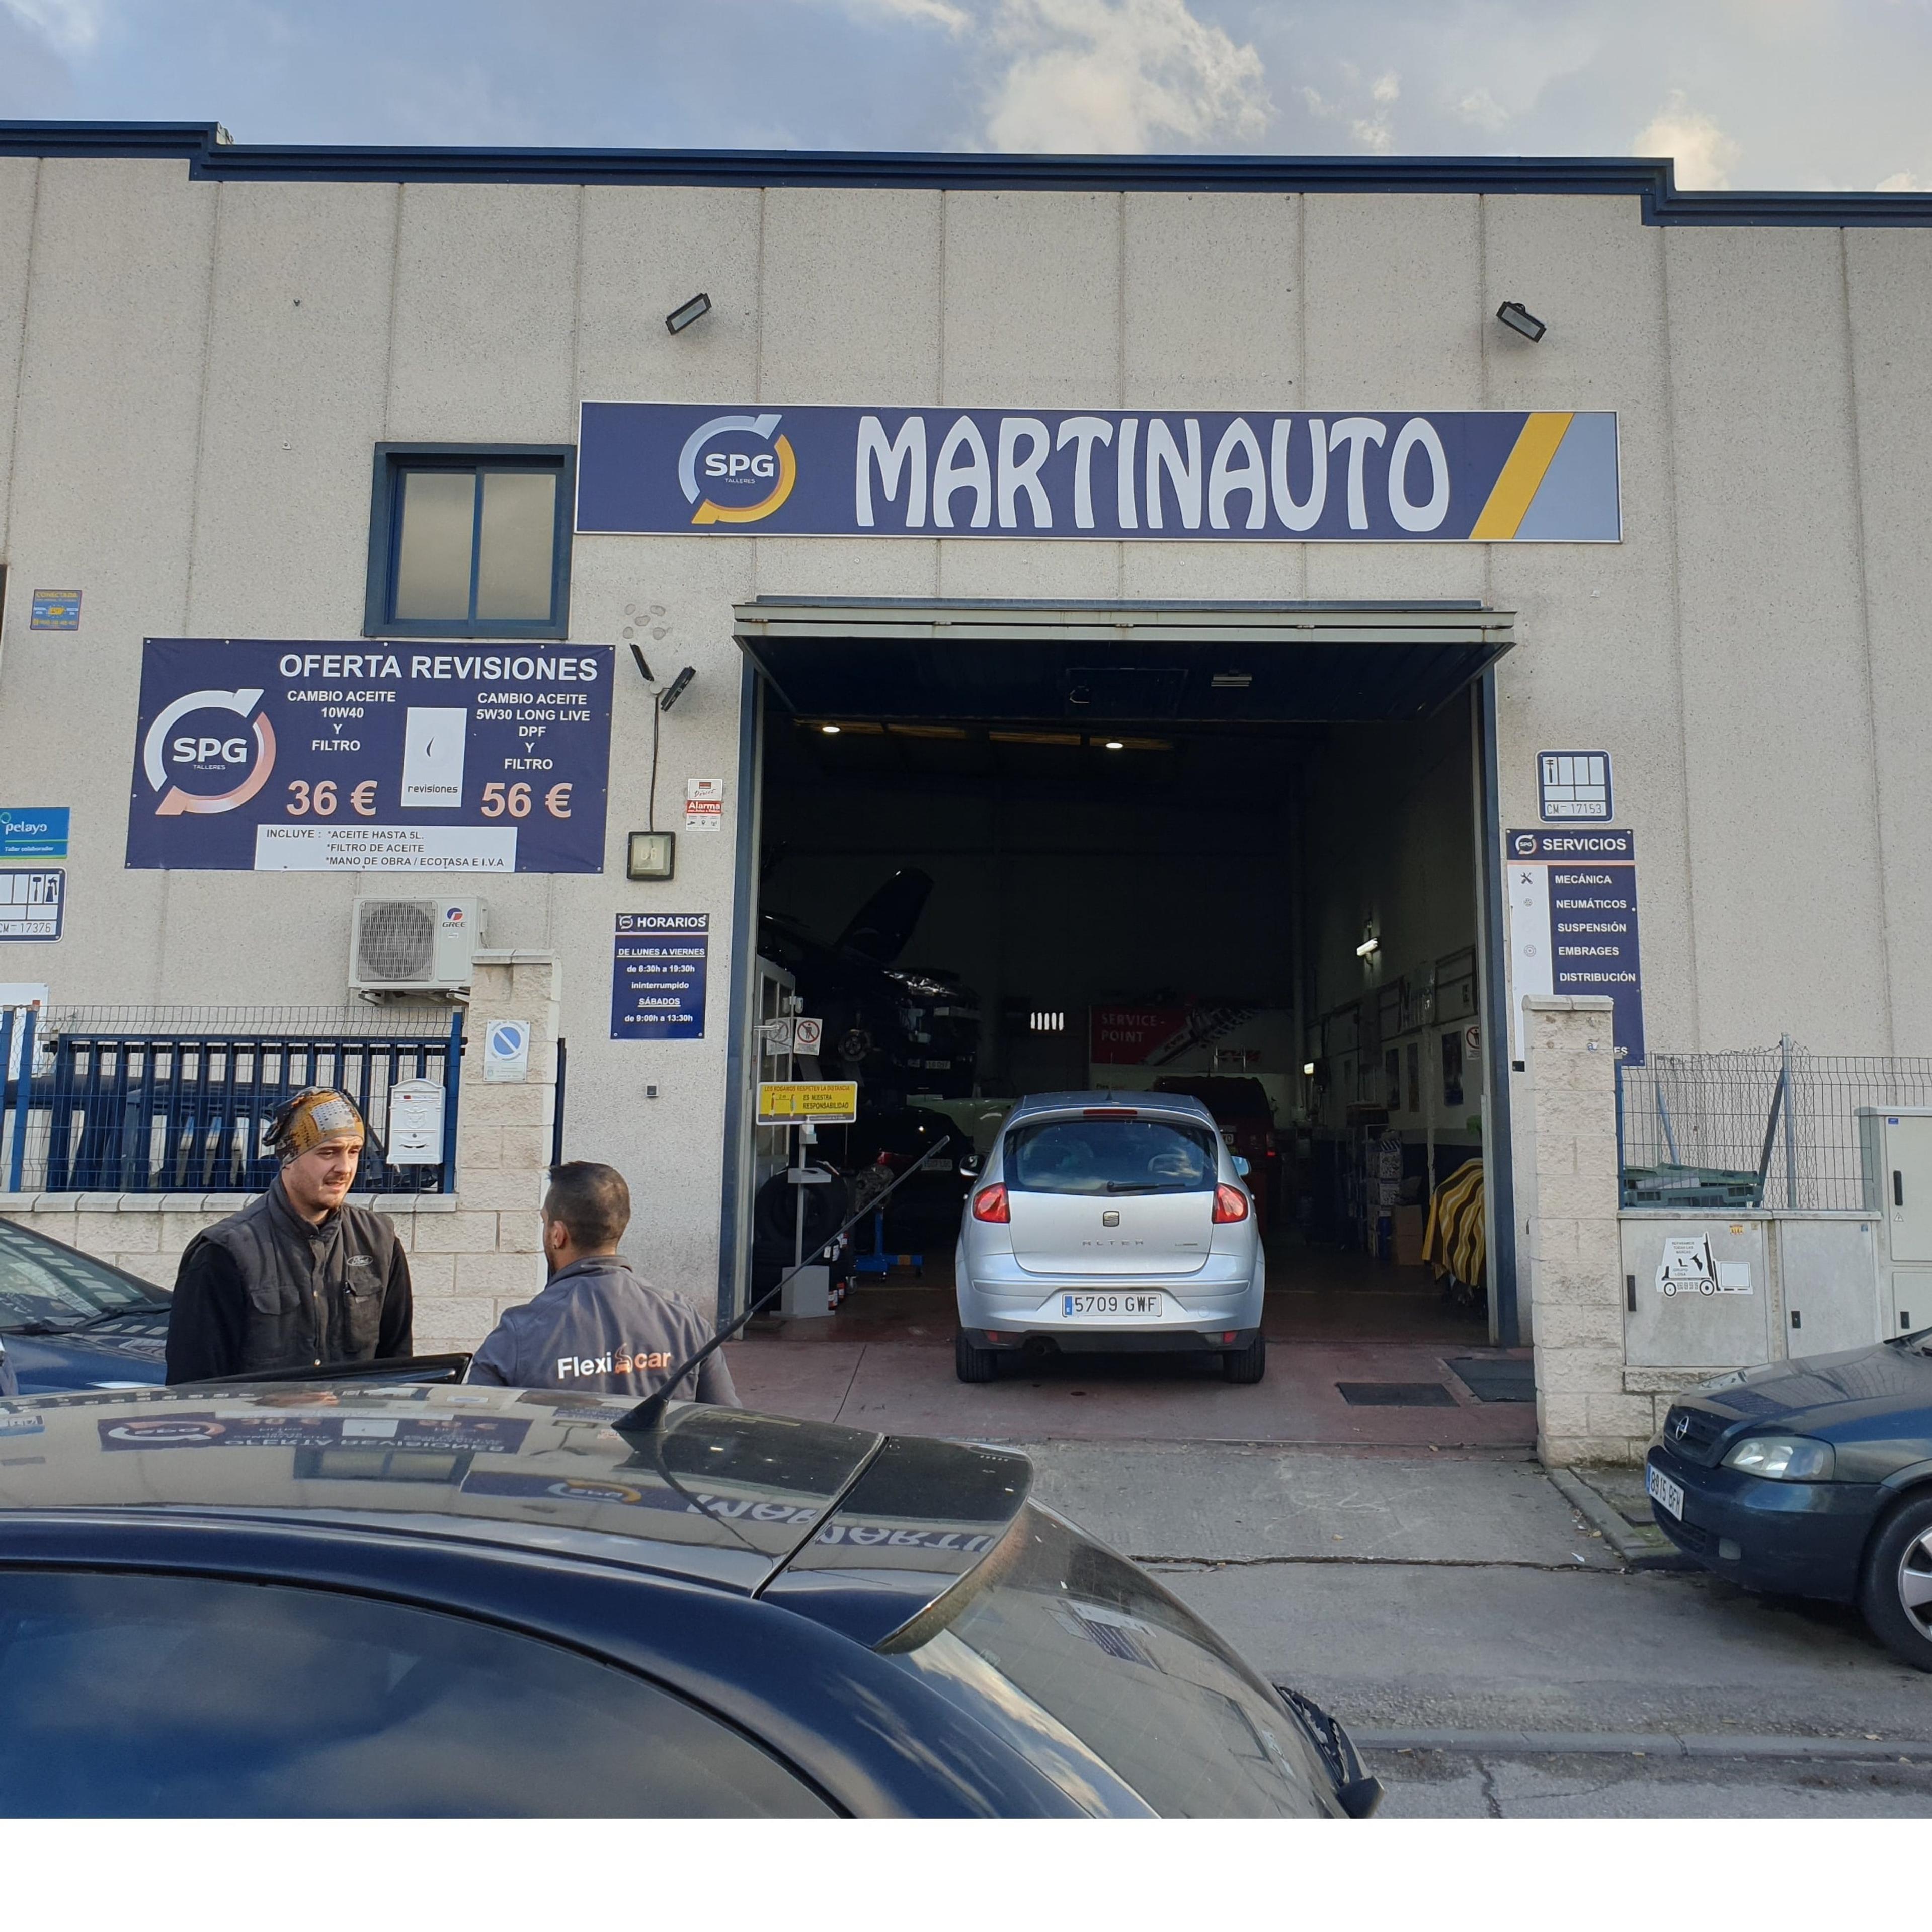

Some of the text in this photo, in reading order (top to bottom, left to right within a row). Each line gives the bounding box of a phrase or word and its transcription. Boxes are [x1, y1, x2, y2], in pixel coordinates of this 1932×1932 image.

[706, 454, 774, 477] SPG
[856, 416, 1449, 531] MARTINAUTO
[280, 654, 598, 682] OFERTA REVISIONES
[287, 690, 396, 703] CAMBIO ACEITE
[477, 693, 587, 705] CAMBIO ACEITE
[321, 707, 364, 719] 10W40
[476, 709, 590, 721] 5W30 LONG LIVE
[333, 724, 341, 735] Y
[519, 726, 546, 738] DPF
[172, 738, 247, 764] SPG
[312, 740, 361, 752] FILTRO
[526, 743, 534, 754] Y
[504, 759, 553, 770] FILTRO
[408, 784, 458, 794] revisiones
[286, 780, 378, 816] 36 €
[481, 782, 573, 818] 56 €
[1572, 804, 1602, 814] 17153
[5, 821, 47, 835] pelayo
[267, 829, 315, 838] INCLUYE
[386, 844, 424, 852] ACEITE
[1543, 839, 1626, 851] SERVICIOS
[381, 857, 411, 865] OBRA
[420, 858, 469, 866] ECOTASA
[1555, 874, 1612, 884] MECÁNICA
[1556, 898, 1626, 909] NEUMÁTICOS
[21, 922, 51, 933] 17376
[637, 917, 706, 927] HORARIOS
[1558, 922, 1626, 932] SUSPENSIÓN
[1558, 947, 1619, 955] EMBRAGES
[1560, 971, 1636, 982] DISTRIBUCIÓN
[631, 982, 689, 990] ininterrumpido
[639, 997, 680, 1005] SÁBADOS
[1101, 1013, 1157, 1027] SERVICE
[1101, 1031, 1143, 1043] POINT
[1075, 1296, 1117, 1312] 5709
[1125, 1296, 1157, 1312] GWF
[557, 1352, 671, 1379] Flexi car
